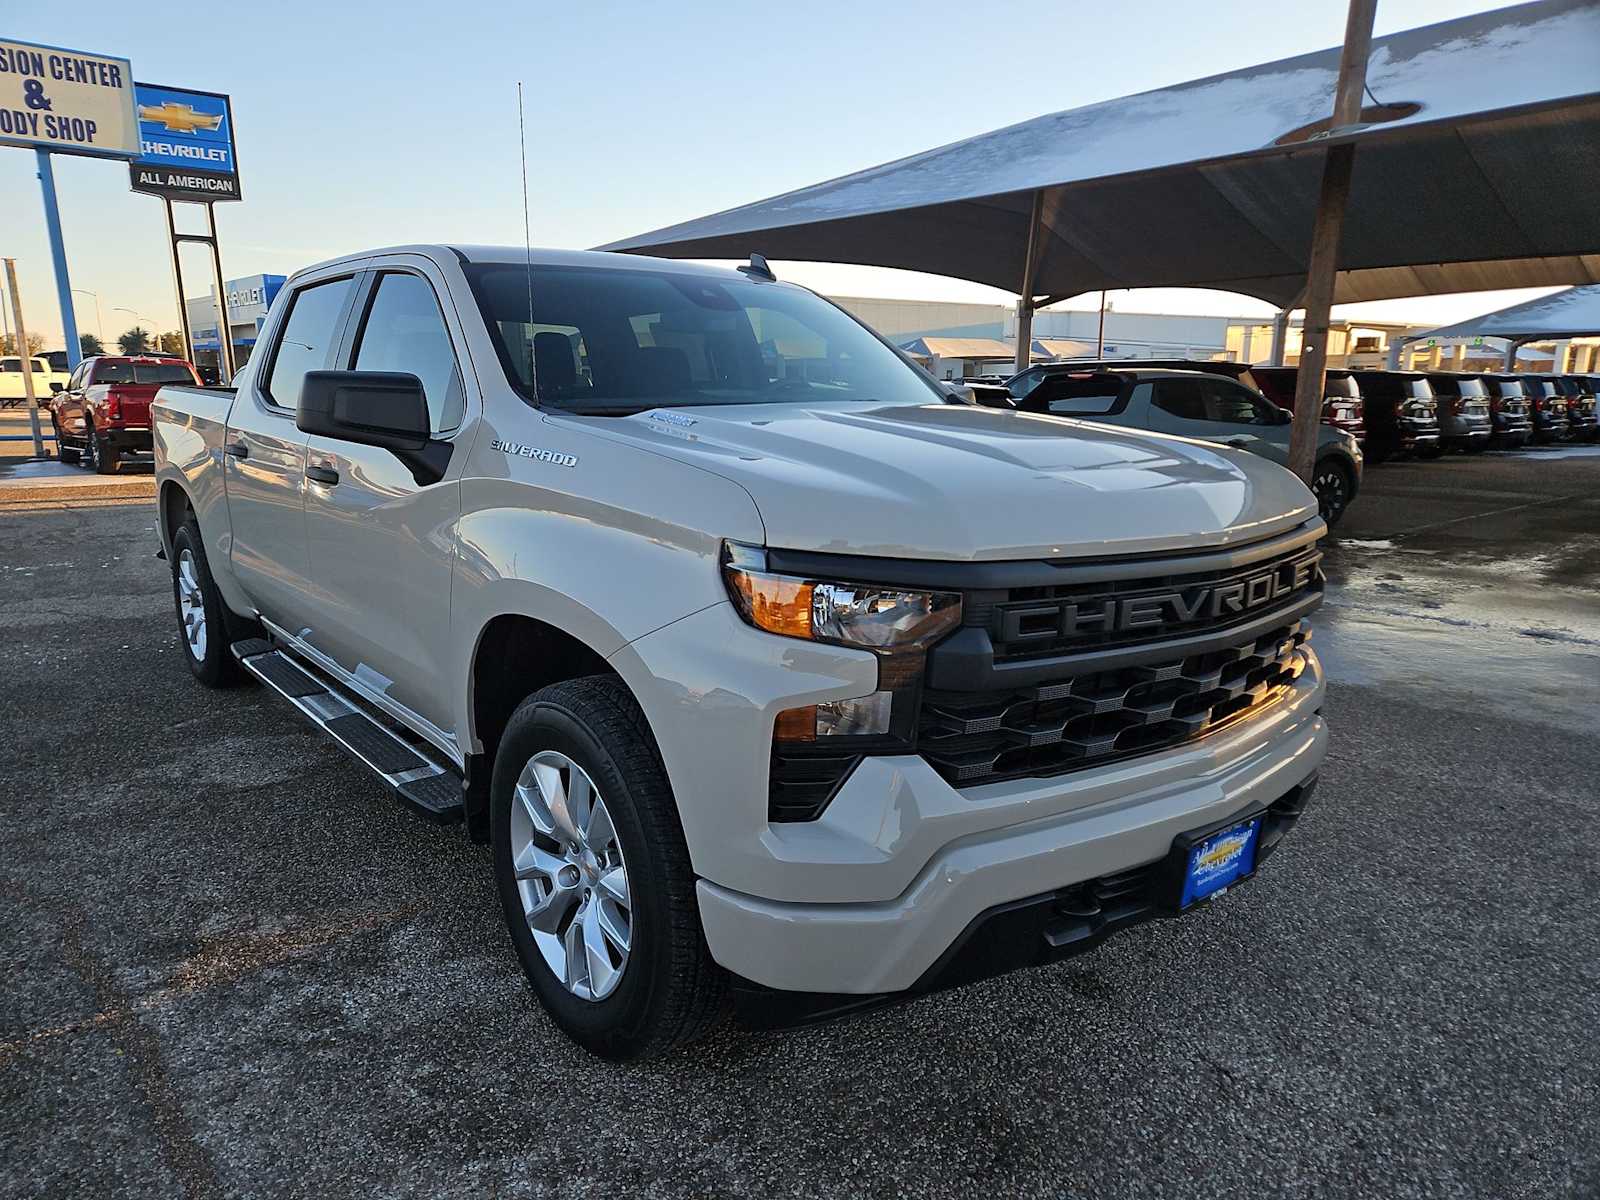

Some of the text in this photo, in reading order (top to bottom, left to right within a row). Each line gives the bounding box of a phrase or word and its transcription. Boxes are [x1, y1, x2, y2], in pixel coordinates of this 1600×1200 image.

[49, 54, 122, 88] CENTER
[24, 78, 52, 111] &
[0, 108, 97, 142] ODY SHOP
[139, 171, 233, 191] ALL AMERICAN
[491, 440, 577, 467] SILVERADO
